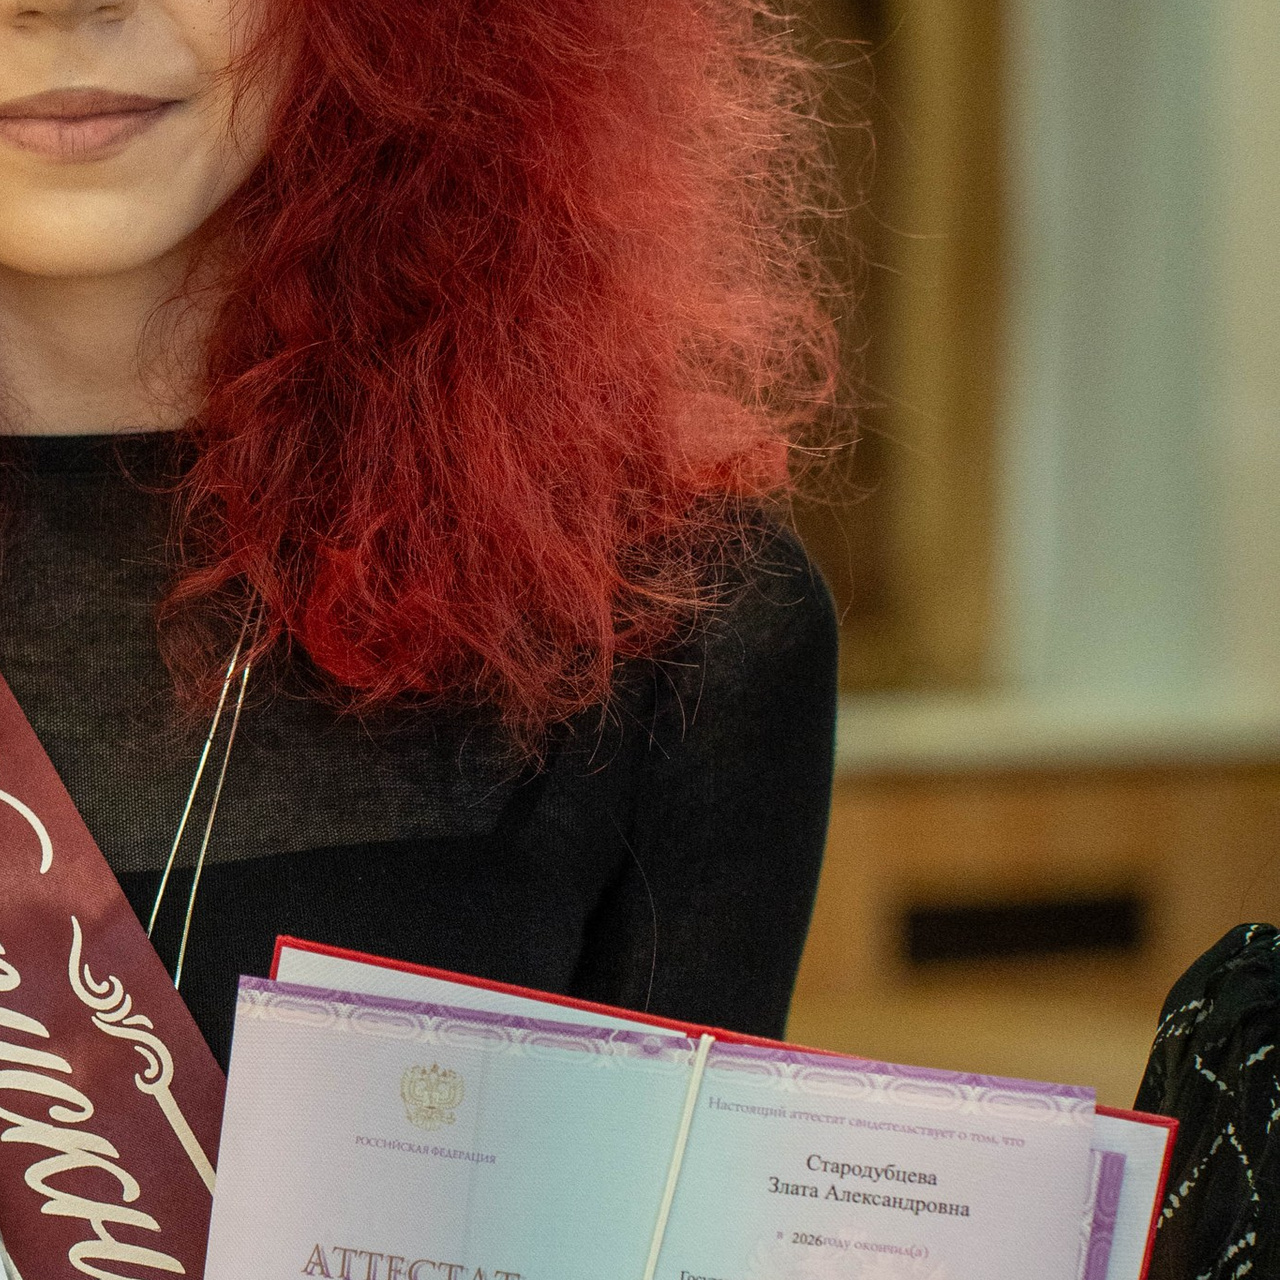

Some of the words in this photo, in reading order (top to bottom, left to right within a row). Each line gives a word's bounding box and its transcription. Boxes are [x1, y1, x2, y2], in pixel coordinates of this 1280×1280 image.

[708, 1096, 786, 1119] Настоящий
[790, 1109, 845, 1126] аттестат
[848, 1118, 955, 1141] свидетельствует
[958, 1131, 966, 1140] о
[1002, 1136, 1025, 1148] что
[354, 1135, 428, 1156] РОССИЙСКАЯ
[431, 1145, 497, 1165] ФЕДЕРАЦИЯ
[806, 1154, 938, 1187] Стародубцева
[768, 1177, 819, 1199] Злата
[824, 1186, 970, 1218] Александровна
[854, 1241, 929, 1259] окончил(а)
